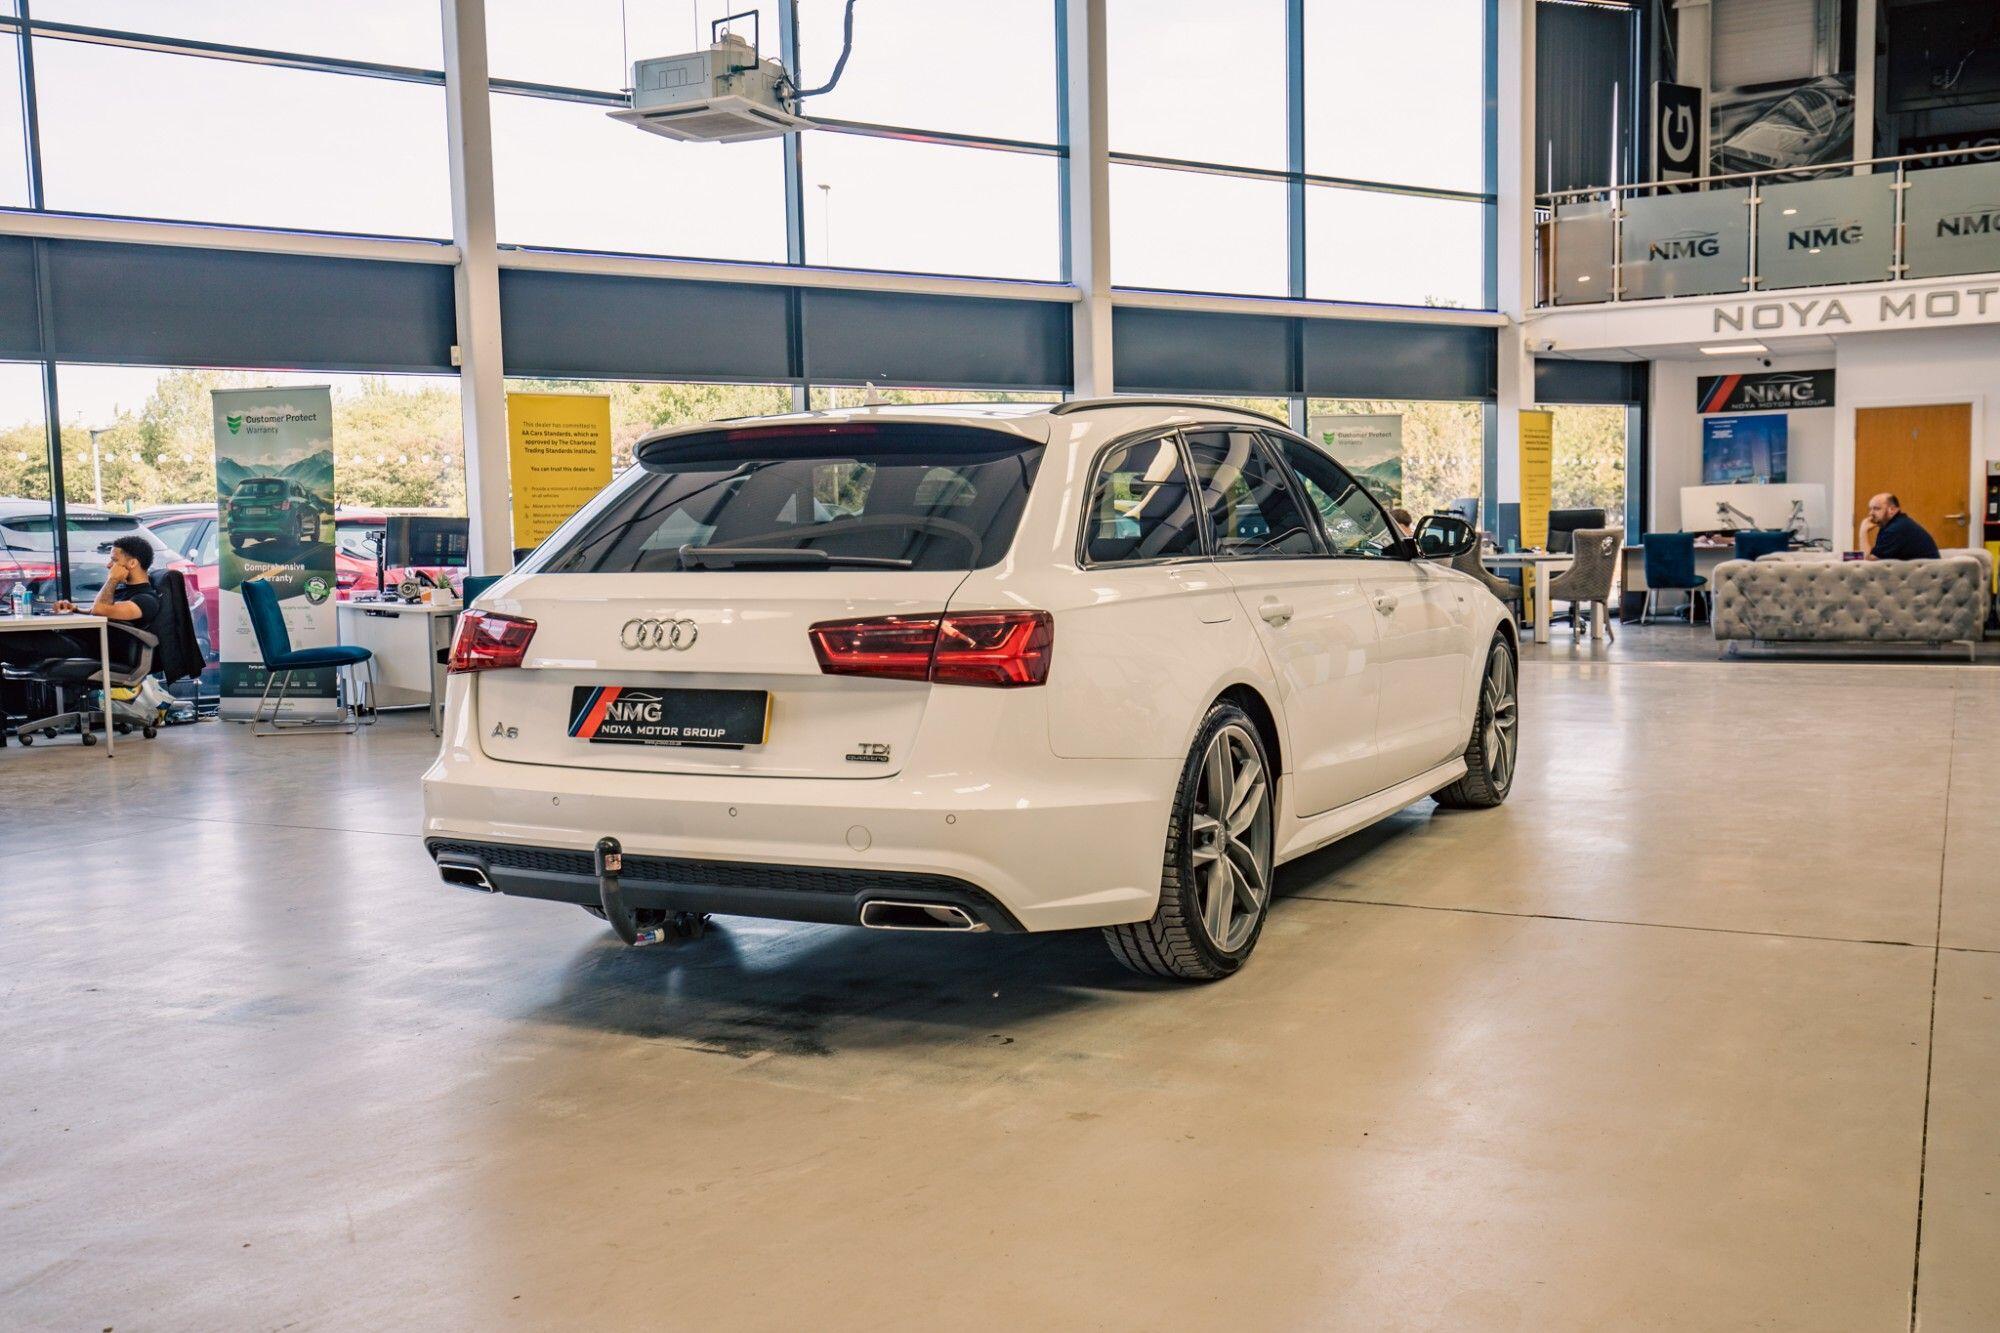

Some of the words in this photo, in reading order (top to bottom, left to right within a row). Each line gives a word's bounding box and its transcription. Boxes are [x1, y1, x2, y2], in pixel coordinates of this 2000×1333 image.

[1788, 225, 1863, 250] NMG
[1650, 237, 1720, 261] NMG
[1714, 299, 1851, 332] NOYA
[1880, 287, 1999, 321] MOT
[1744, 382, 1814, 403] NMG
[245, 415, 285, 423] Customer
[286, 413, 317, 422] Protect
[246, 427, 278, 435] Warranty
[244, 562, 305, 572] Comprehensive
[605, 702, 663, 722] NMG
[491, 721, 519, 739] A6
[601, 724, 632, 734] NOYA
[636, 726, 678, 736] MOTOR
[683, 728, 726, 738] GROUP
